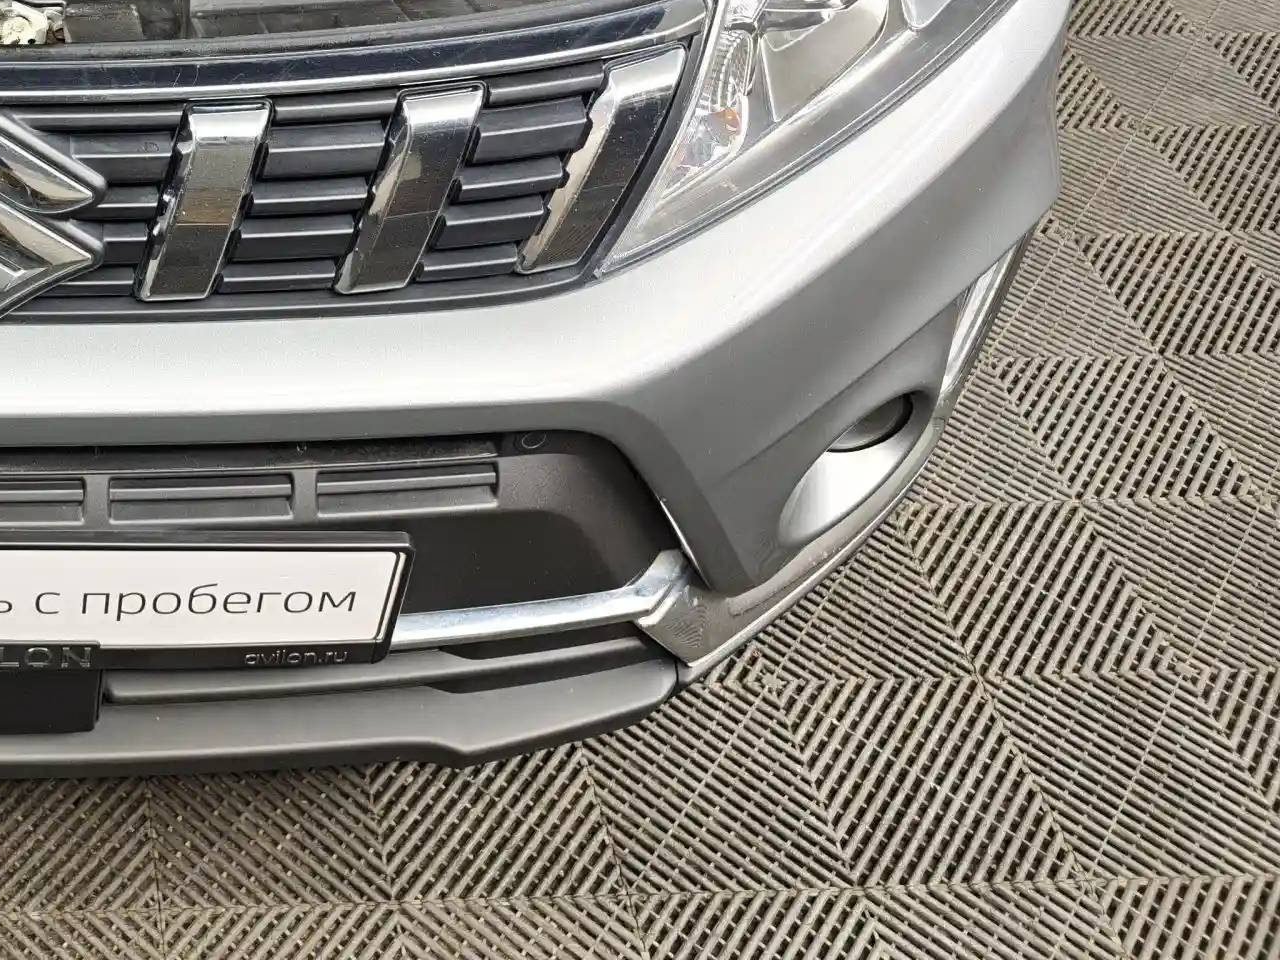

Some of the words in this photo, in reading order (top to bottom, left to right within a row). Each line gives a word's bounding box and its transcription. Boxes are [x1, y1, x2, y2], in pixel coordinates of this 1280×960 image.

[34, 591, 61, 615] с
[81, 583, 357, 621] пробегом
[244, 649, 348, 665] avilon.ru
